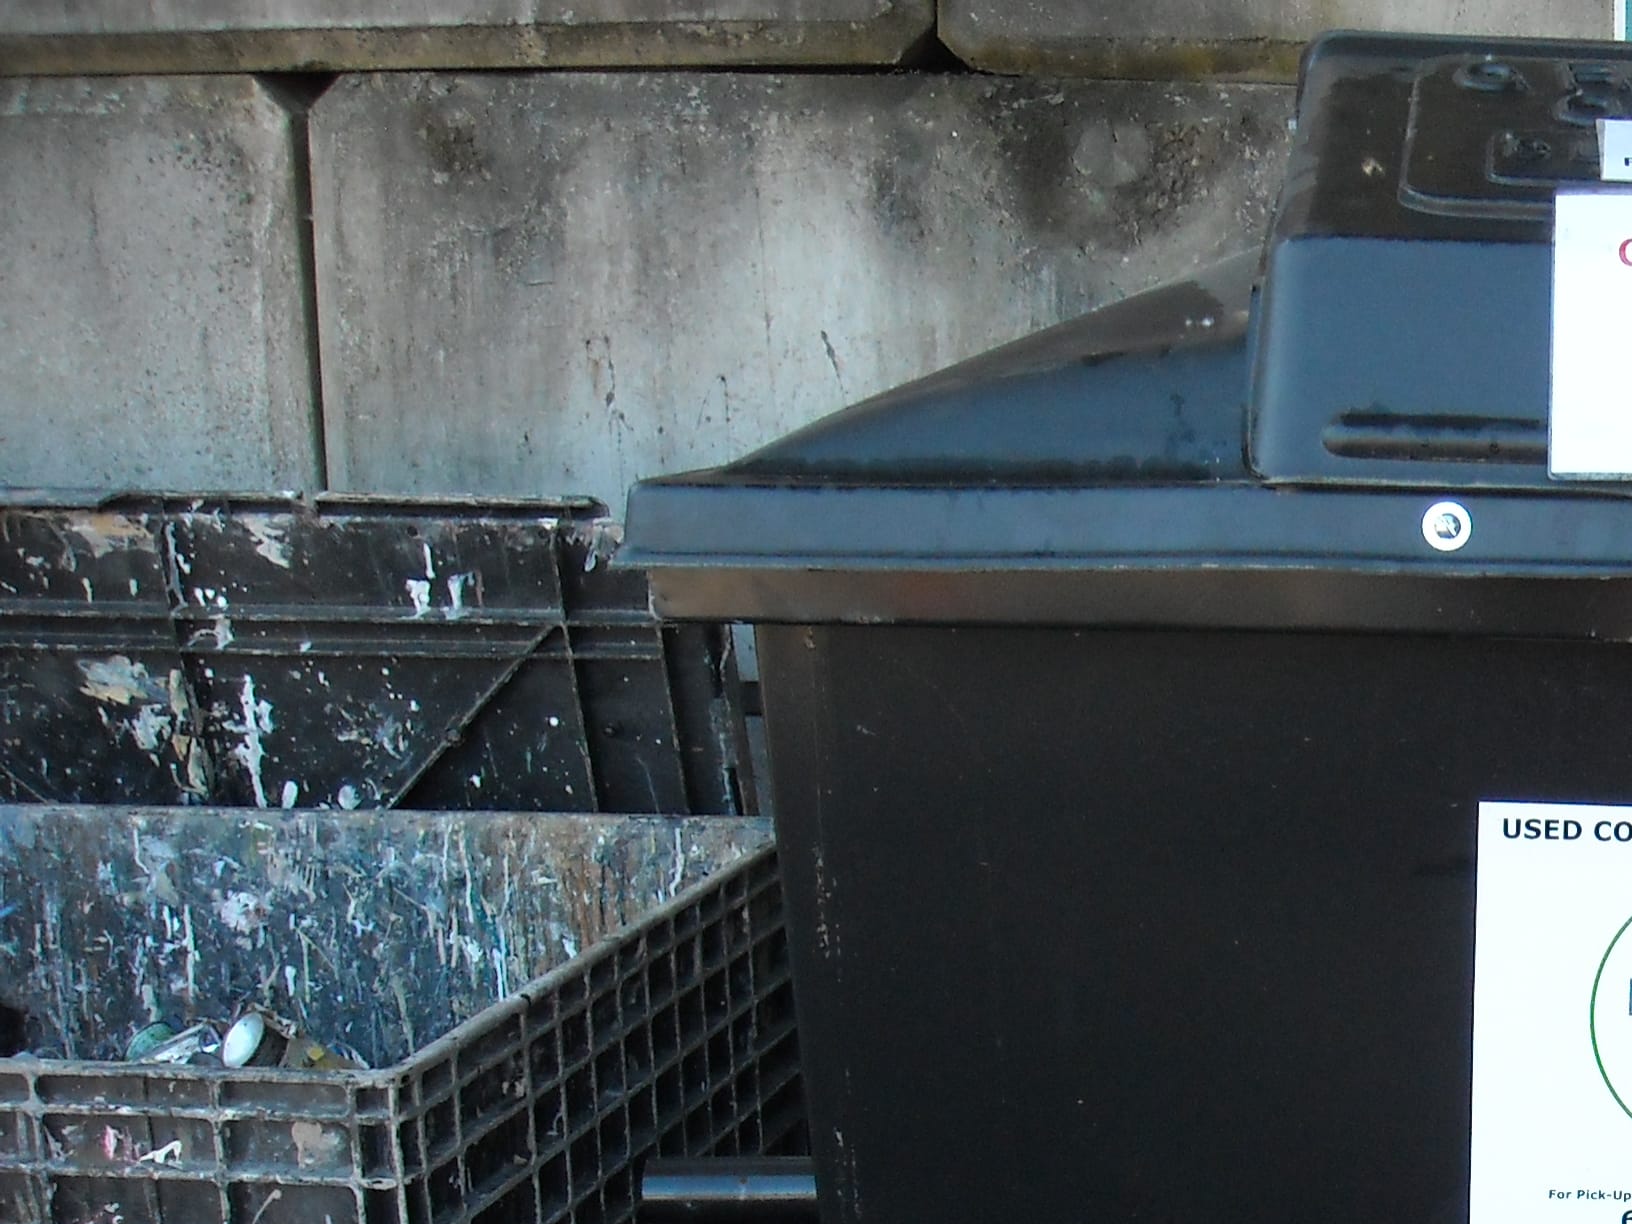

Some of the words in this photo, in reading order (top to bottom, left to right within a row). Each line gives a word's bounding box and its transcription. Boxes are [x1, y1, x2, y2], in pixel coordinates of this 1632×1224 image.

[1502, 818, 1583, 842] USED
[1548, 1189, 1571, 1200] For
[1577, 1189, 1631, 1202] Pick-Up
